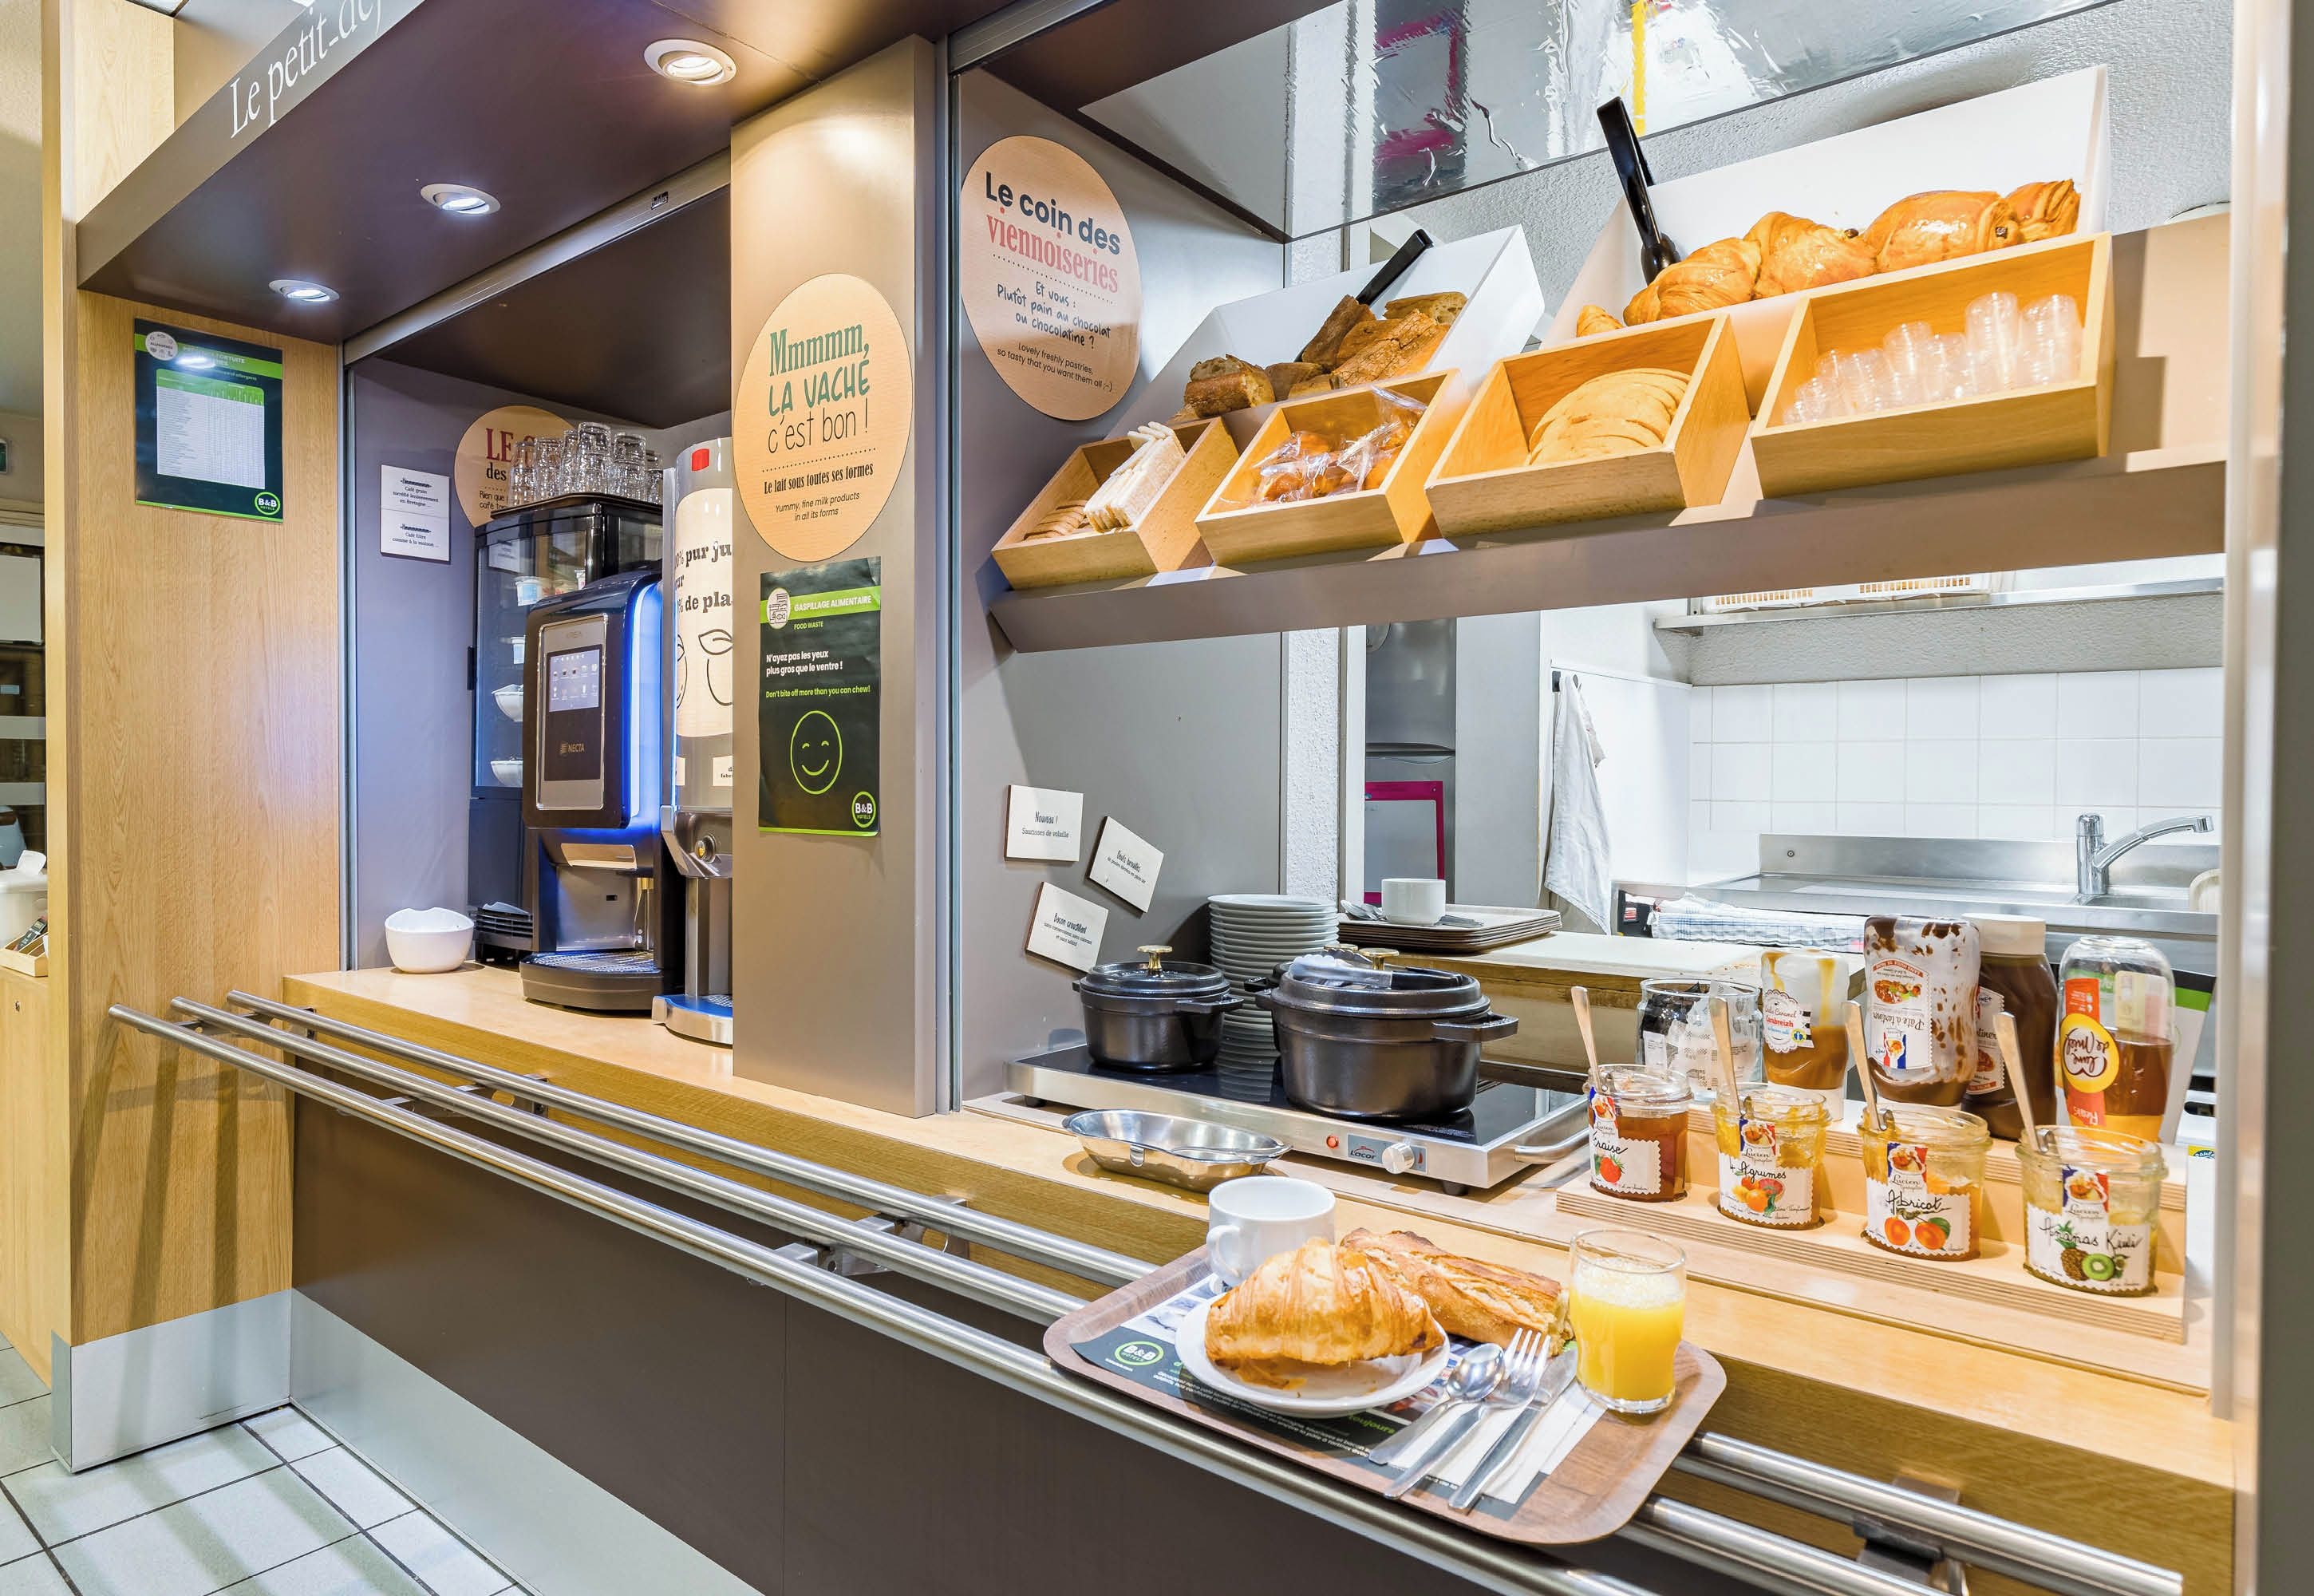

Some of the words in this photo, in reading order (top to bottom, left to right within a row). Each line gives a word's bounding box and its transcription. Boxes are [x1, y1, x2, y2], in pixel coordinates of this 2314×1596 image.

[229, 77, 261, 139] Le
[985, 171, 1013, 207] Le
[1019, 194, 1072, 235] coin
[1078, 217, 1120, 255] des
[986, 207, 1118, 293] viennoiseries
[1036, 281, 1044, 296] Et
[1048, 290, 1069, 306] vous
[997, 283, 1027, 307] Plutôt
[1030, 298, 1052, 316] pain
[1056, 310, 1068, 322] au
[1072, 313, 1111, 338] chocolat
[1015, 312, 1028, 324] ou
[1032, 317, 1085, 346] chocolatine
[1088, 336, 1095, 350] ?
[1018, 342, 1041, 357] Lovely
[1041, 351, 1064, 367] freshly
[1065, 359, 1093, 375] pastries,
[997, 348, 1006, 358] so
[1007, 350, 1025, 365] tasty
[1027, 357, 1041, 368] that
[1042, 362, 1056, 373] you
[1056, 367, 1074, 380] want
[1075, 372, 1092, 385] them
[1094, 380, 1103, 389] all
[768, 381, 793, 417] LA
[804, 359, 871, 409] VACHE
[768, 411, 814, 454] c'est
[822, 407, 856, 443] bon
[864, 397, 868, 433] !
[485, 428, 515, 463] LE
[486, 461, 507, 481] des
[764, 480, 772, 495] Le
[774, 478, 787, 492] lait
[788, 476, 804, 490] sous
[807, 472, 830, 487] toutes
[831, 469, 843, 483] ses
[846, 463, 874, 480] formes
[258, 497, 278, 508] B&B
[479, 490, 492, 500] Rien
[494, 494, 505, 503] que
[479, 500, 494, 510] café
[776, 501, 800, 513] Yummy,
[802, 499, 814, 508] fine
[815, 496, 828, 507] milk
[830, 492, 860, 506] products
[794, 512, 800, 522] in
[810, 509, 819, 519] its
[819, 508, 839, 518] forms
[686, 546, 709, 567] pur
[685, 595, 699, 611] de
[794, 600, 830, 612] GASPILLAGE
[831, 595, 872, 607] ALIMENTAIRE
[766, 654, 788, 663] N'ayez
[788, 653, 800, 662] pas
[811, 650, 829, 661] yeux
[766, 666, 780, 678] plus
[780, 666, 795, 677] gros
[796, 665, 808, 675] que
[809, 663, 815, 672] le
[816, 662, 839, 671] ventre
[828, 687, 839, 696] you
[852, 685, 871, 693] chew!
[568, 743, 585, 753] NECTA
[855, 802, 873, 814] B&B
[1035, 811, 1054, 824] Nouveau
[1021, 828, 1044, 836] Saucisses
[1052, 829, 1069, 838] volaille
[1896, 1017, 1901, 1026] à
[1350, 1149, 1377, 1160] Lacor
[1742, 1148, 1770, 1160] Lucien
[1737, 1161, 1787, 1184] Agrumes
[1889, 1174, 1921, 1187] Lucien
[1886, 1189, 1943, 1215] Abricot
[2039, 1217, 2099, 1247] Ananas
[1123, 1345, 1156, 1361] B&B
